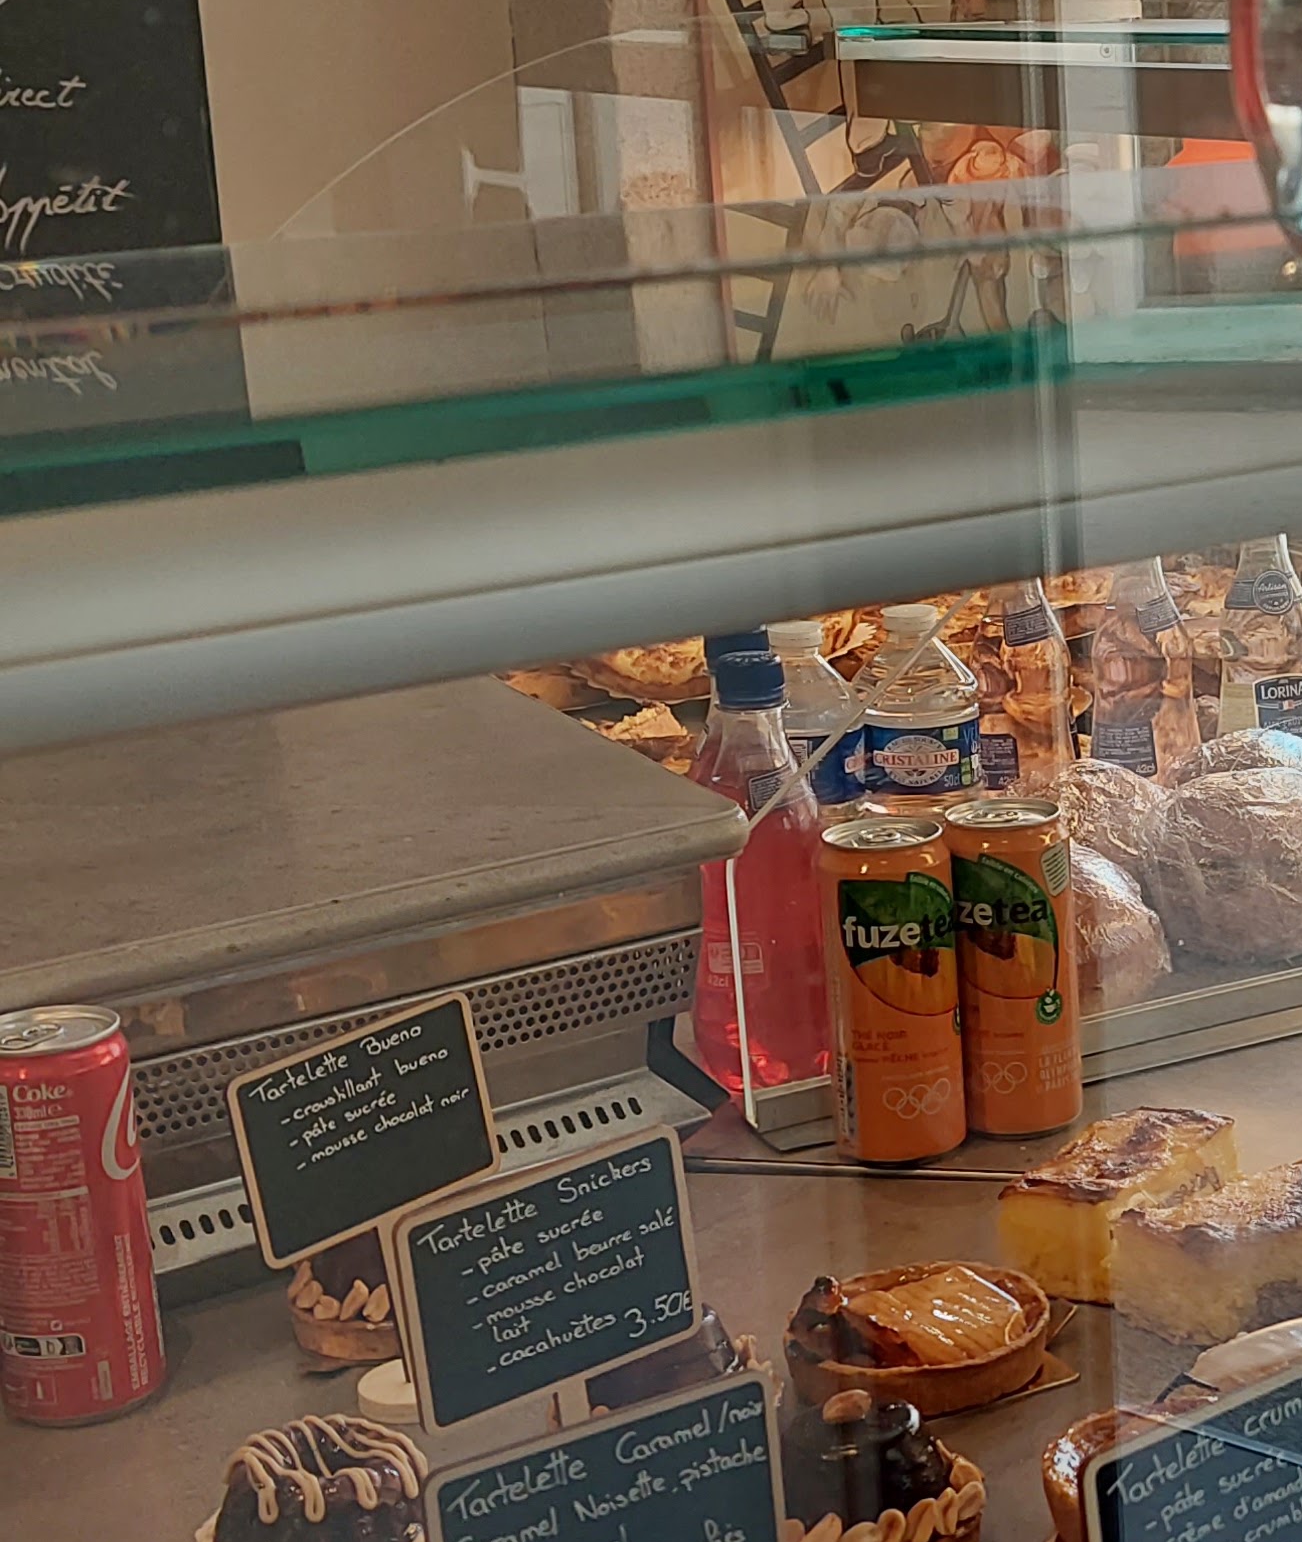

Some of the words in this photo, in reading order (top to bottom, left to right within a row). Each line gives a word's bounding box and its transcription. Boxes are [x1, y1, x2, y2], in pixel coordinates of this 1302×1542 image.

[874, 751, 958, 768] CRISTALINE
[13, 1083, 66, 1103] Coke
[249, 1053, 348, 1102] Tartelette
[360, 1025, 421, 1055] Bueno
[293, 1066, 382, 1120] croustillant
[394, 1049, 448, 1076] bueno
[302, 1117, 336, 1147] pâte
[344, 1090, 397, 1122] sucrée
[311, 1128, 368, 1163] mousse
[375, 1094, 434, 1133] chocolat
[441, 1087, 470, 1108] noir
[416, 1198, 538, 1255] Tartelette
[557, 1157, 652, 1203] Snickers
[478, 1236, 525, 1275] pâte
[537, 1210, 604, 1244] sucrée
[482, 1252, 562, 1299] caramel
[573, 1230, 632, 1261] beurre
[639, 1207, 675, 1235] salé
[487, 1290, 556, 1326] mousse
[563, 1246, 644, 1294] chocolat
[493, 1316, 532, 1343] lait
[499, 1313, 617, 1367] cacahuètes
[446, 1449, 588, 1522] Tartelette
[615, 1409, 711, 1465] Caramel
[1107, 1429, 1226, 1505] Tartelette
[1160, 1483, 1206, 1532] pâte
